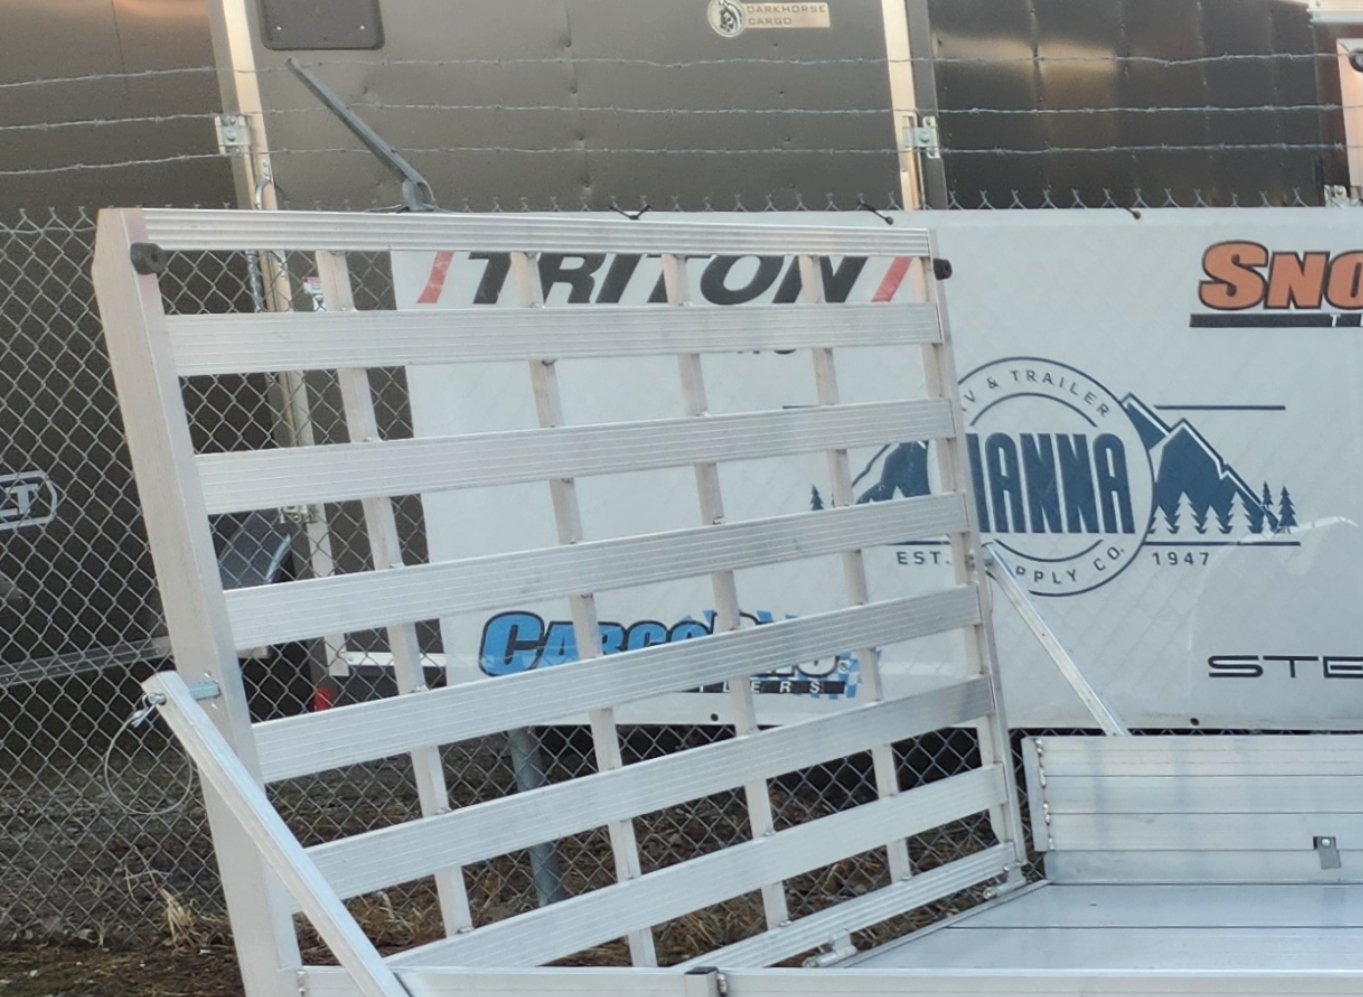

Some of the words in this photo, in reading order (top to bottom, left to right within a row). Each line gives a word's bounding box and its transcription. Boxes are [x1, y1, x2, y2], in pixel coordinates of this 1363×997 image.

[747, 4, 827, 14] DARKHORSE
[748, 17, 793, 26] CARGO
[468, 251, 868, 305] TRITON
[986, 377, 999, 389] &
[1009, 369, 1110, 418] TRAILER
[897, 550, 951, 566] EST.
[1152, 551, 1210, 566] 1947
[1014, 565, 1079, 585] PPLY
[1092, 546, 1125, 572] CO.
